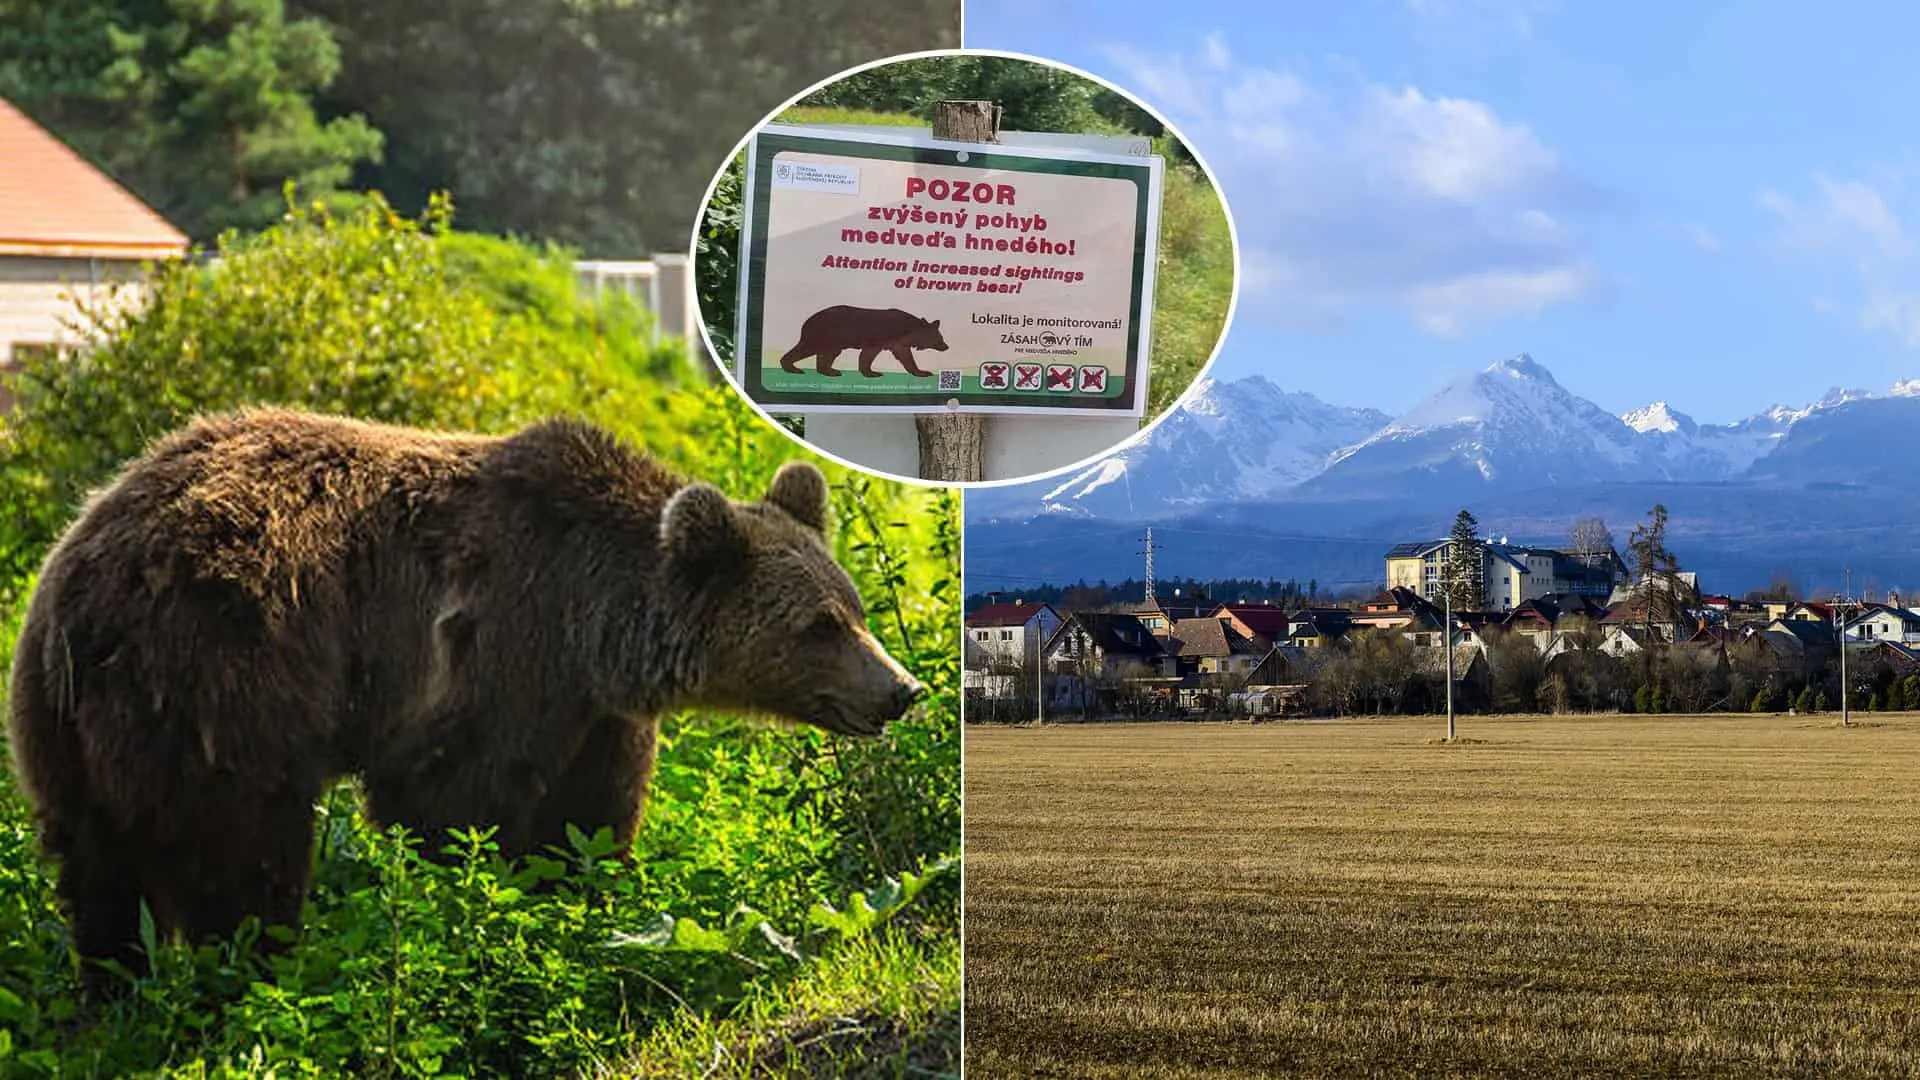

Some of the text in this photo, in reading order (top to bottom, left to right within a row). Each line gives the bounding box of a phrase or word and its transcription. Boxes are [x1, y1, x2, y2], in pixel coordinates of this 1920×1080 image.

[906, 177, 1016, 205] POZOR
[867, 204, 1047, 233] zvýšený pohyb
[841, 227, 1076, 256] medveďa hnedého!
[821, 254, 1085, 283] Attention increased sightings
[894, 276, 1023, 294] of brown bear!
[971, 312, 1122, 329] Lokalita je monitorovaná!
[1074, 335, 1093, 347] TÍM
